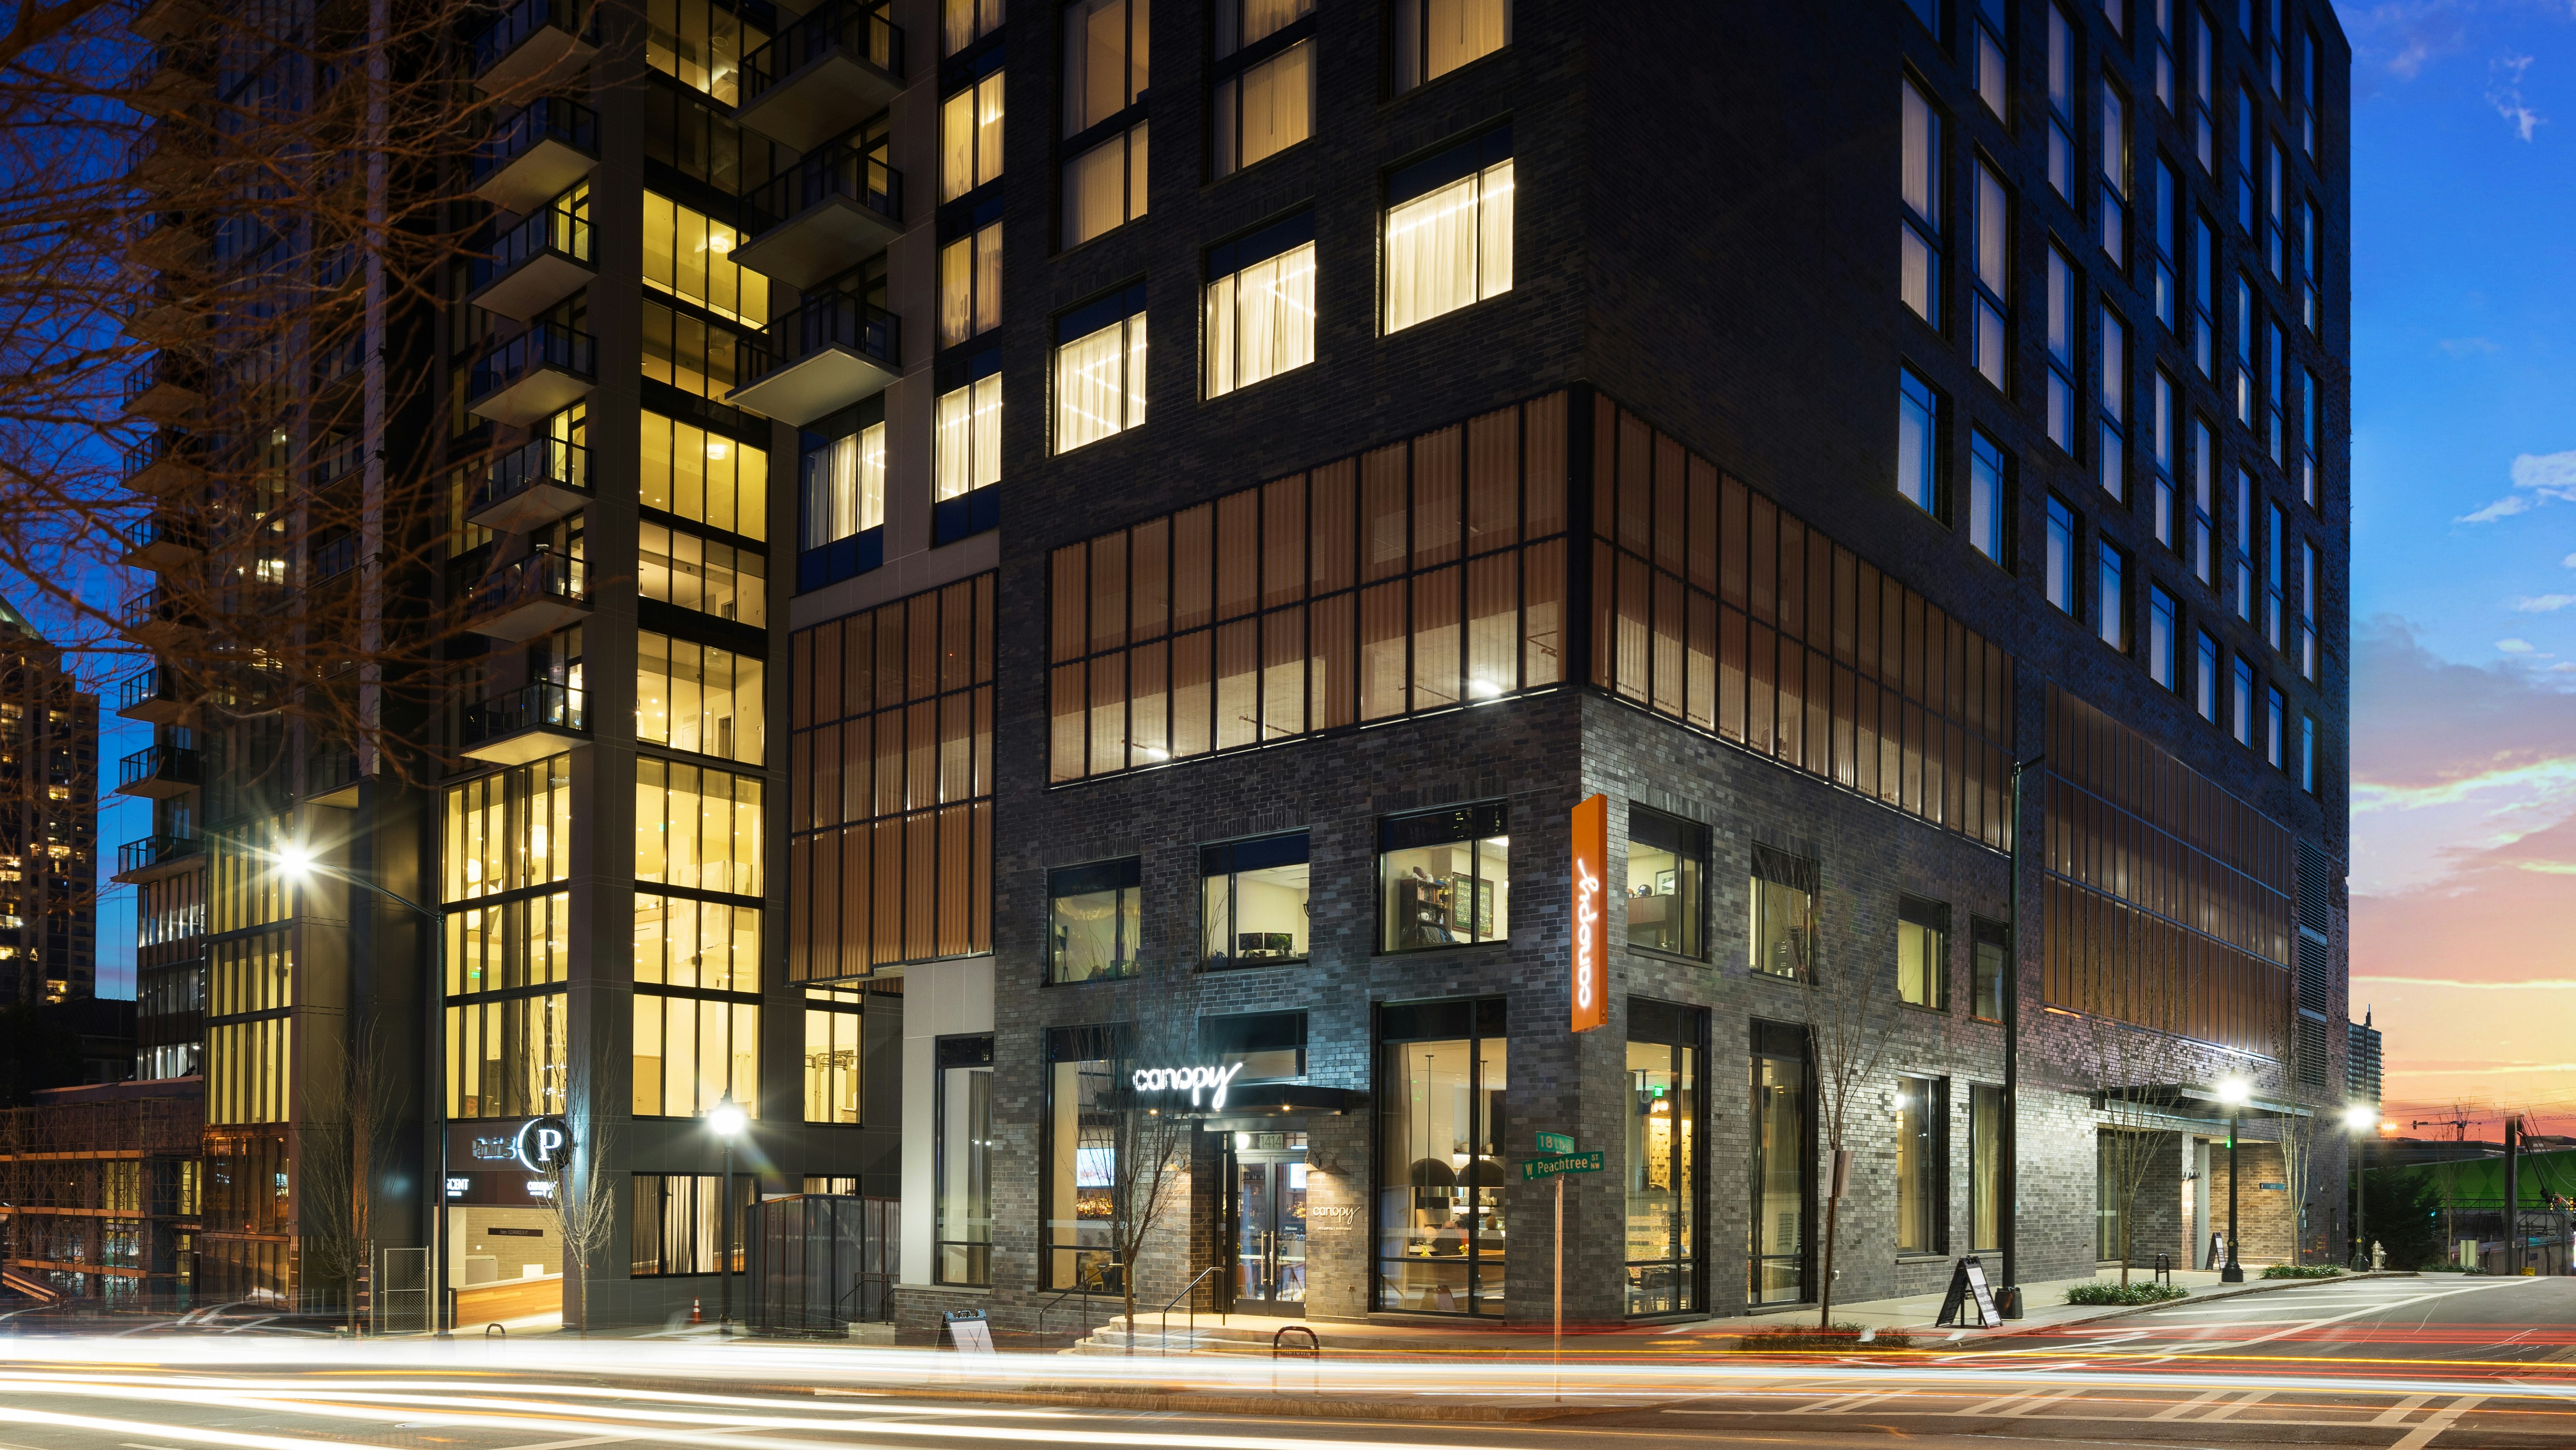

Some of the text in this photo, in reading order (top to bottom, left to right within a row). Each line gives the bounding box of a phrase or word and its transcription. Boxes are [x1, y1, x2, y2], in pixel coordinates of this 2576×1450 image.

[1578, 858, 1599, 1008] canopy
[1132, 1062, 1243, 1109] canopy
[472, 1129, 562, 1161] Parking P
[1260, 1136, 1282, 1148] 1414
[1540, 1135, 1565, 1150] 18th
[1526, 1158, 1588, 1175] W Peachtree
[1313, 1206, 1361, 1225] canopy
[1281, 1347, 1311, 1356] MIDTOWN
